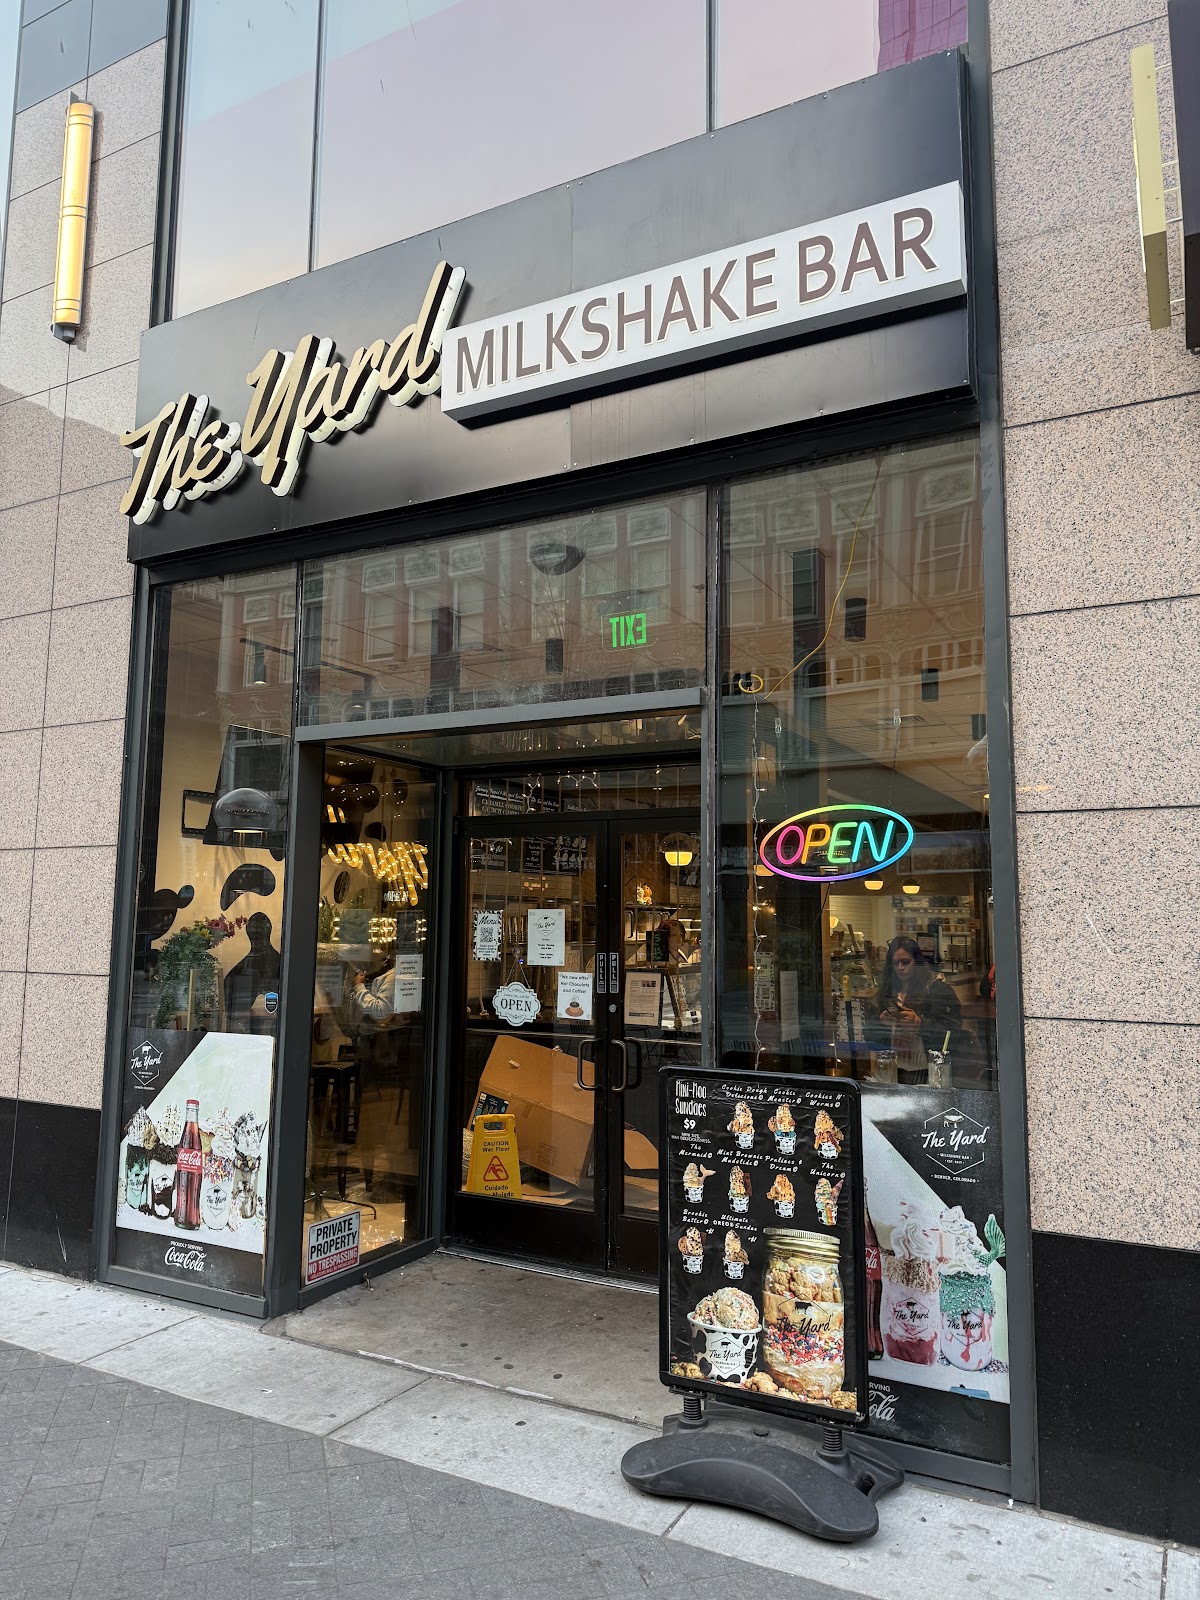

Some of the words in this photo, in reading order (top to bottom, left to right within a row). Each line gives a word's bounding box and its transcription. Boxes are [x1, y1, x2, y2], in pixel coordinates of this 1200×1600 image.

[455, 247, 779, 395] MILKSHAKE
[798, 206, 938, 305] BAR
[119, 392, 241, 525] The
[241, 260, 465, 496] Yard
[776, 819, 895, 866] OPEN
[478, 915, 498, 925] Menu
[500, 998, 532, 1012] OPEN
[130, 1057, 143, 1070] The
[143, 1052, 163, 1071] Yard
[721, 1083, 743, 1092] Cookie
[746, 1085, 768, 1095] Dough
[773, 1088, 796, 1096] Cookie
[805, 1091, 833, 1100] Cookies
[675, 1098, 707, 1117] Sundaes
[683, 1118, 696, 1130] $9
[921, 1130, 946, 1149] The
[950, 1126, 990, 1151] Yard
[178, 1149, 202, 1167] Coca-Cola
[716, 1149, 734, 1157] Mint
[735, 1150, 763, 1160] Brownie
[764, 1155, 795, 1165] Pralines
[821, 1162, 834, 1170] The
[206, 1195, 214, 1204] The
[214, 1196, 227, 1207] Yard
[720, 1213, 749, 1223] Ultimate
[316, 1217, 353, 1242] PRIVATE
[735, 1223, 758, 1232] Sundae
[170, 1240, 187, 1249] PROUDLY
[187, 1243, 204, 1252] SERVING
[310, 1231, 358, 1260] PROPERTY
[164, 1246, 208, 1272] Coca-Cola
[308, 1262, 317, 1275] NO
[318, 1247, 358, 1272] TRESPASSING
[895, 1309, 908, 1320] The
[909, 1309, 930, 1323] Yard
[800, 1313, 834, 1340] Yard
[947, 1319, 961, 1330] The
[962, 1319, 984, 1333] Yard
[709, 1349, 722, 1359] The
[723, 1346, 744, 1361] Yard
